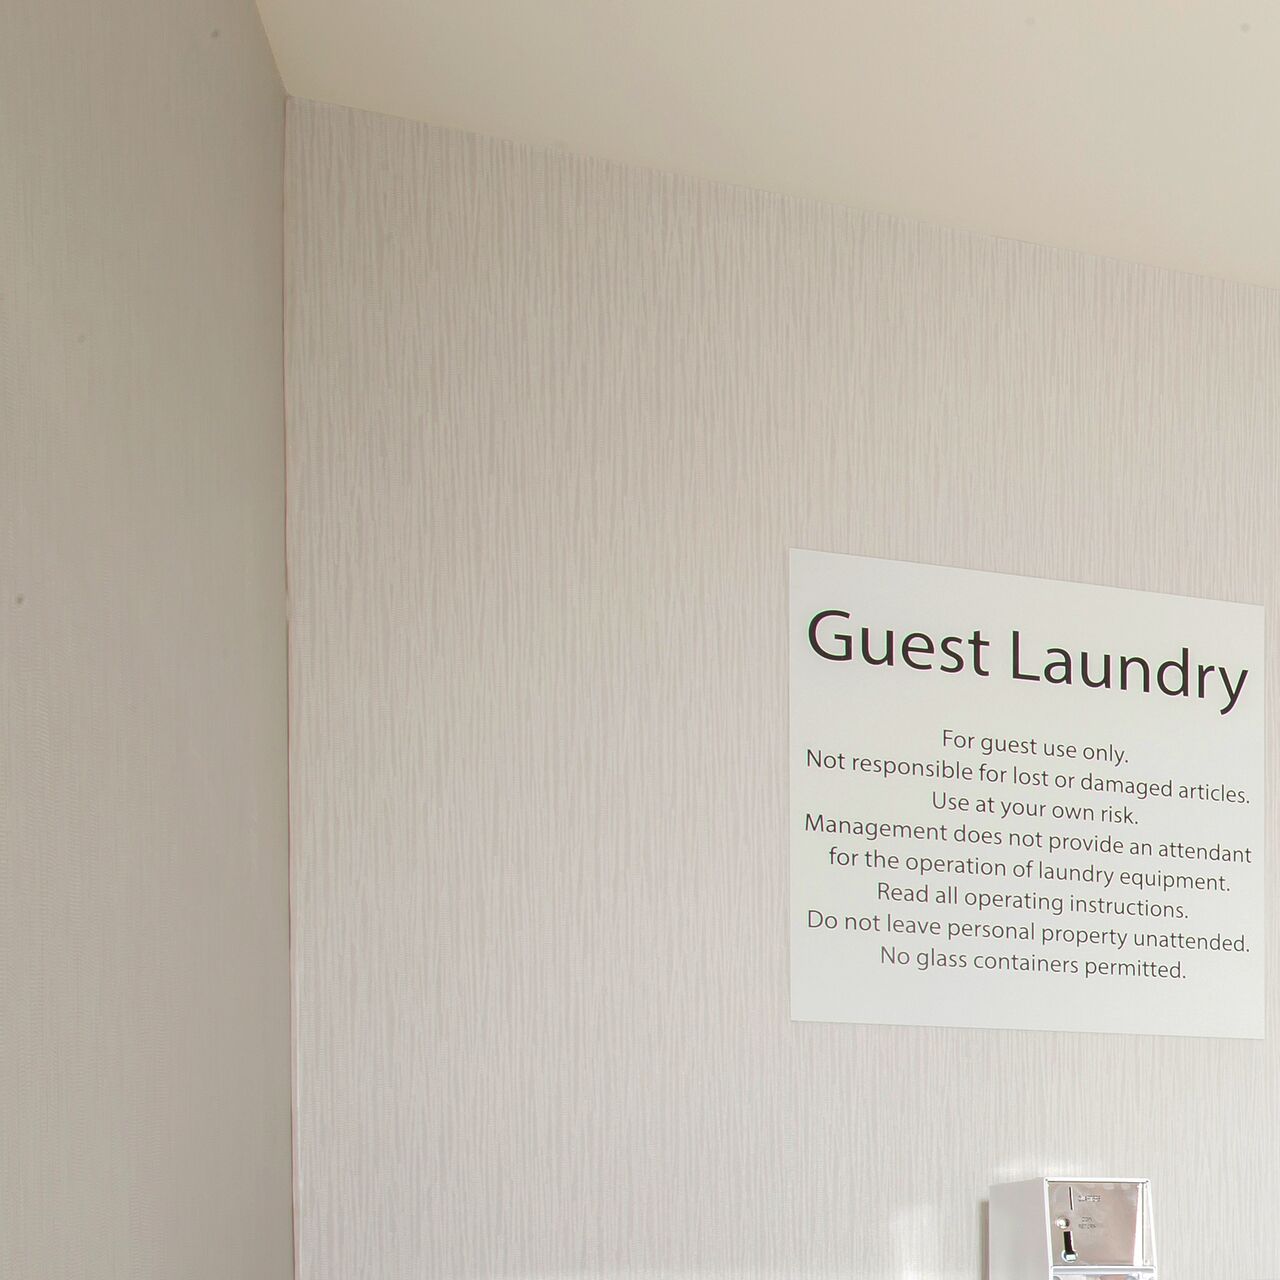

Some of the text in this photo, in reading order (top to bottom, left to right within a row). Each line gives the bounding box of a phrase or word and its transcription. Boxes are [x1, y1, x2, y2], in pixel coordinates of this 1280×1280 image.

[808, 609, 1249, 716] Guest Laundry
[943, 729, 1129, 768] For guest use only.
[807, 748, 1250, 804] Not responsible for lost or damaged articles.
[932, 791, 1138, 825] Use at your own risk.
[805, 813, 1252, 864] Management does not provide an attendant
[828, 846, 1230, 892] for the operation of laundry equipment.
[878, 882, 1188, 919] Read all operating instructions.
[808, 909, 1250, 953] Do not leave personal property unattended.
[881, 945, 1186, 979] No glass containers permitted.
